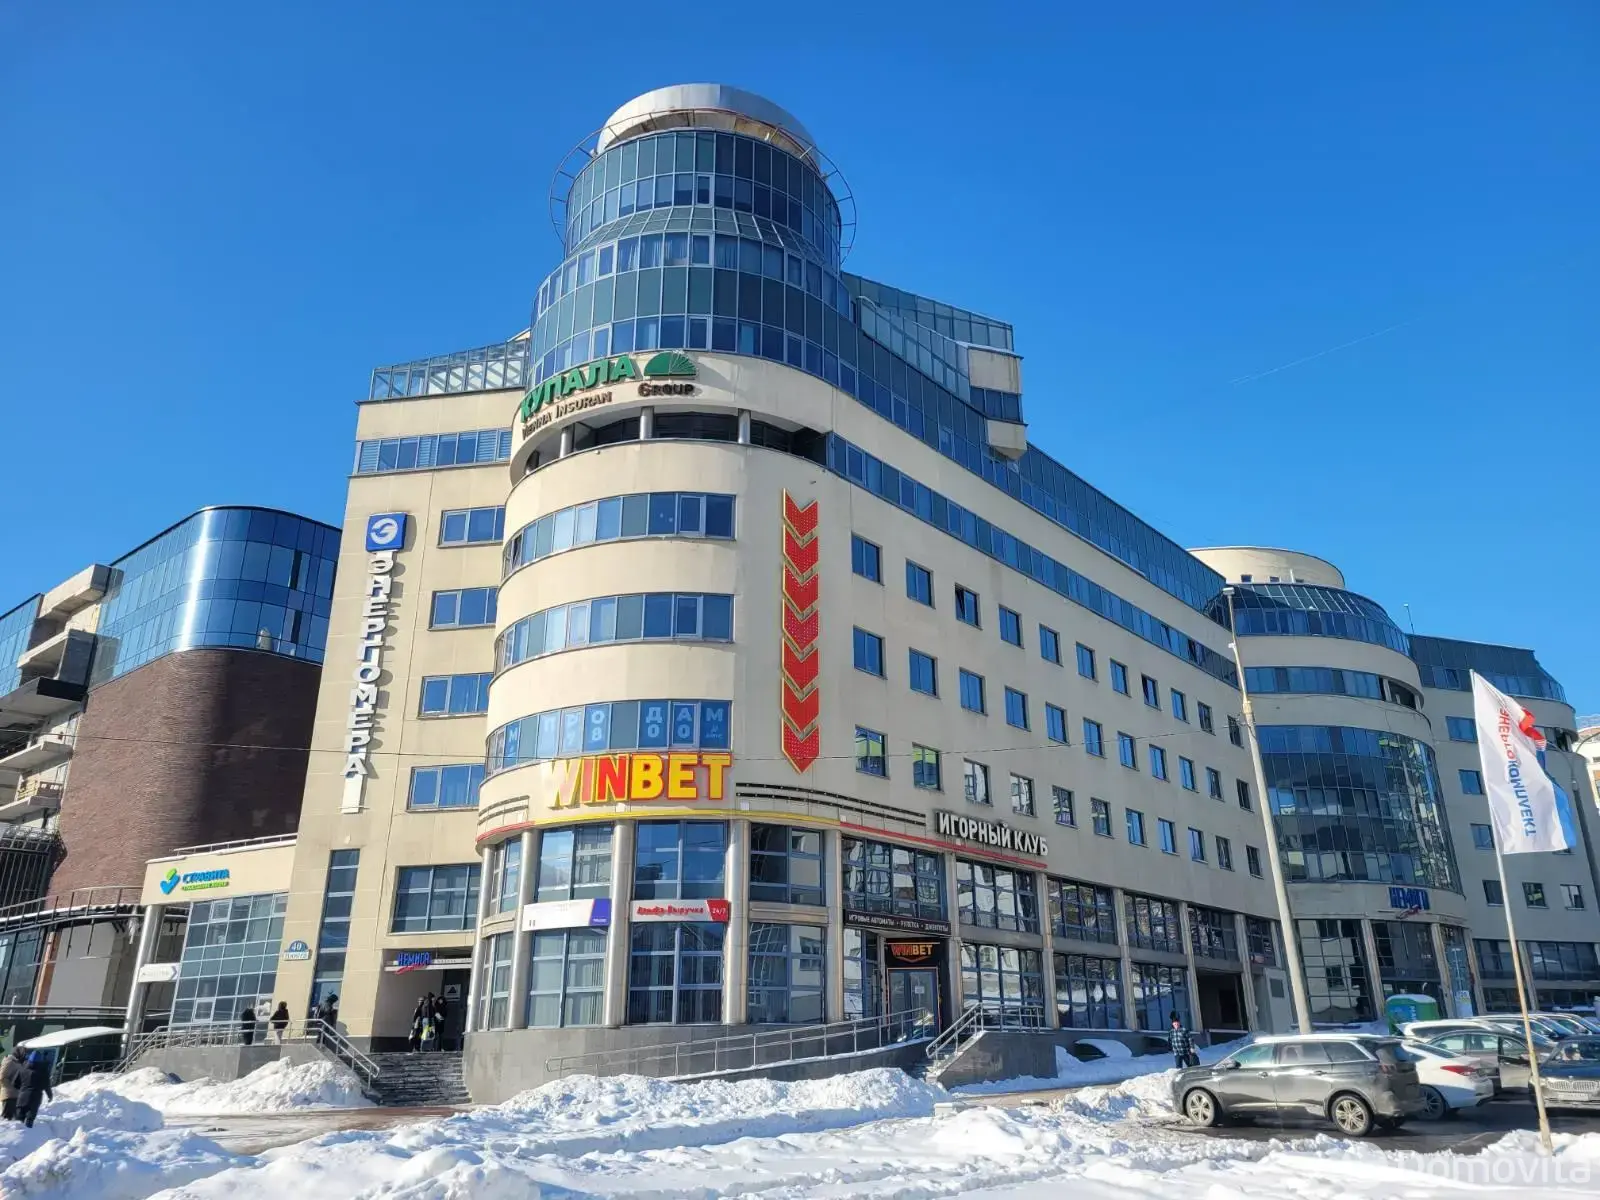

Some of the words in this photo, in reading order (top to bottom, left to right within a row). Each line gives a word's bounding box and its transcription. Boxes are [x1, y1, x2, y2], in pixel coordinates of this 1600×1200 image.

[520, 355, 636, 423] КУПАЛА
[341, 552, 395, 777] ЭНЕРГОМЕРА
[541, 752, 733, 808] WINBET
[938, 811, 1011, 849] ИГОРНЫЙ
[1014, 830, 1049, 856] КЛУБ
[890, 944, 933, 956] WINBET
